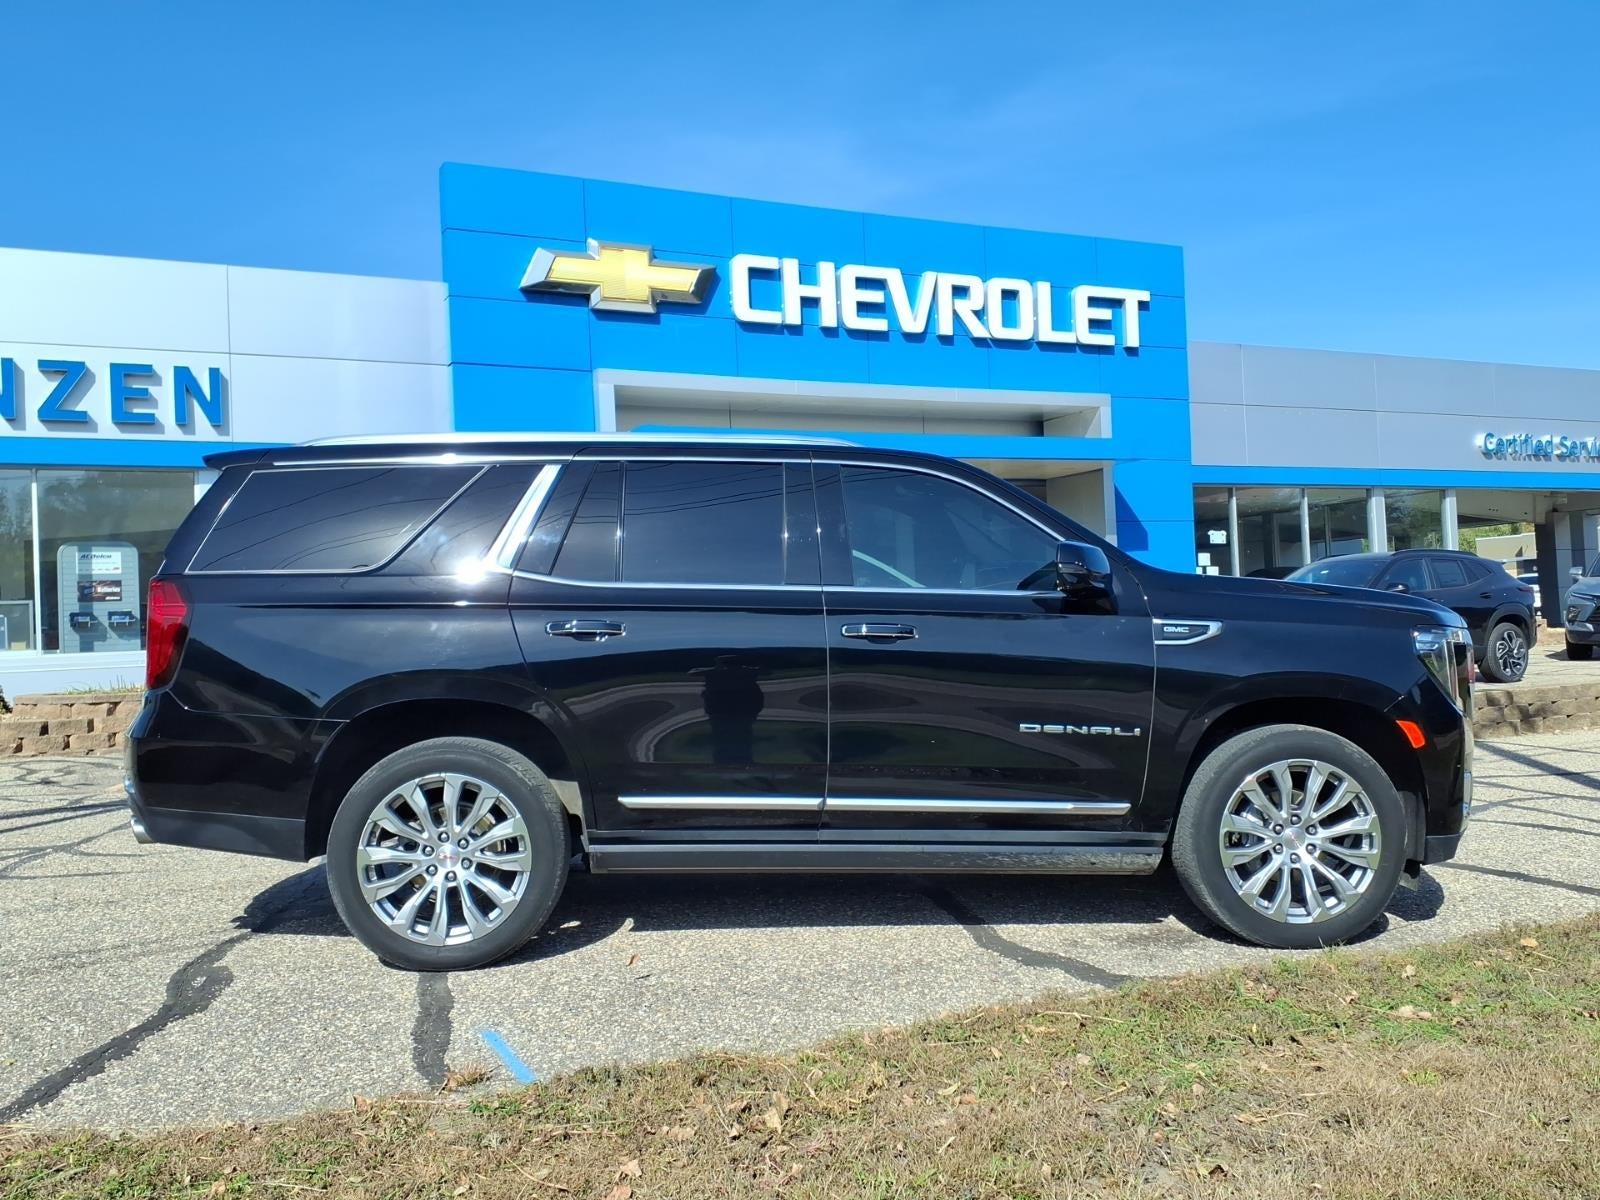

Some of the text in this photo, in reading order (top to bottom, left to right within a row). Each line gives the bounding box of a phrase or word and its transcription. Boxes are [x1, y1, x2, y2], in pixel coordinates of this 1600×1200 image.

[730, 253, 1151, 349] CHEVROLET
[1484, 432, 1600, 457] Certified Servi
[1019, 723, 1141, 737] DENALI
